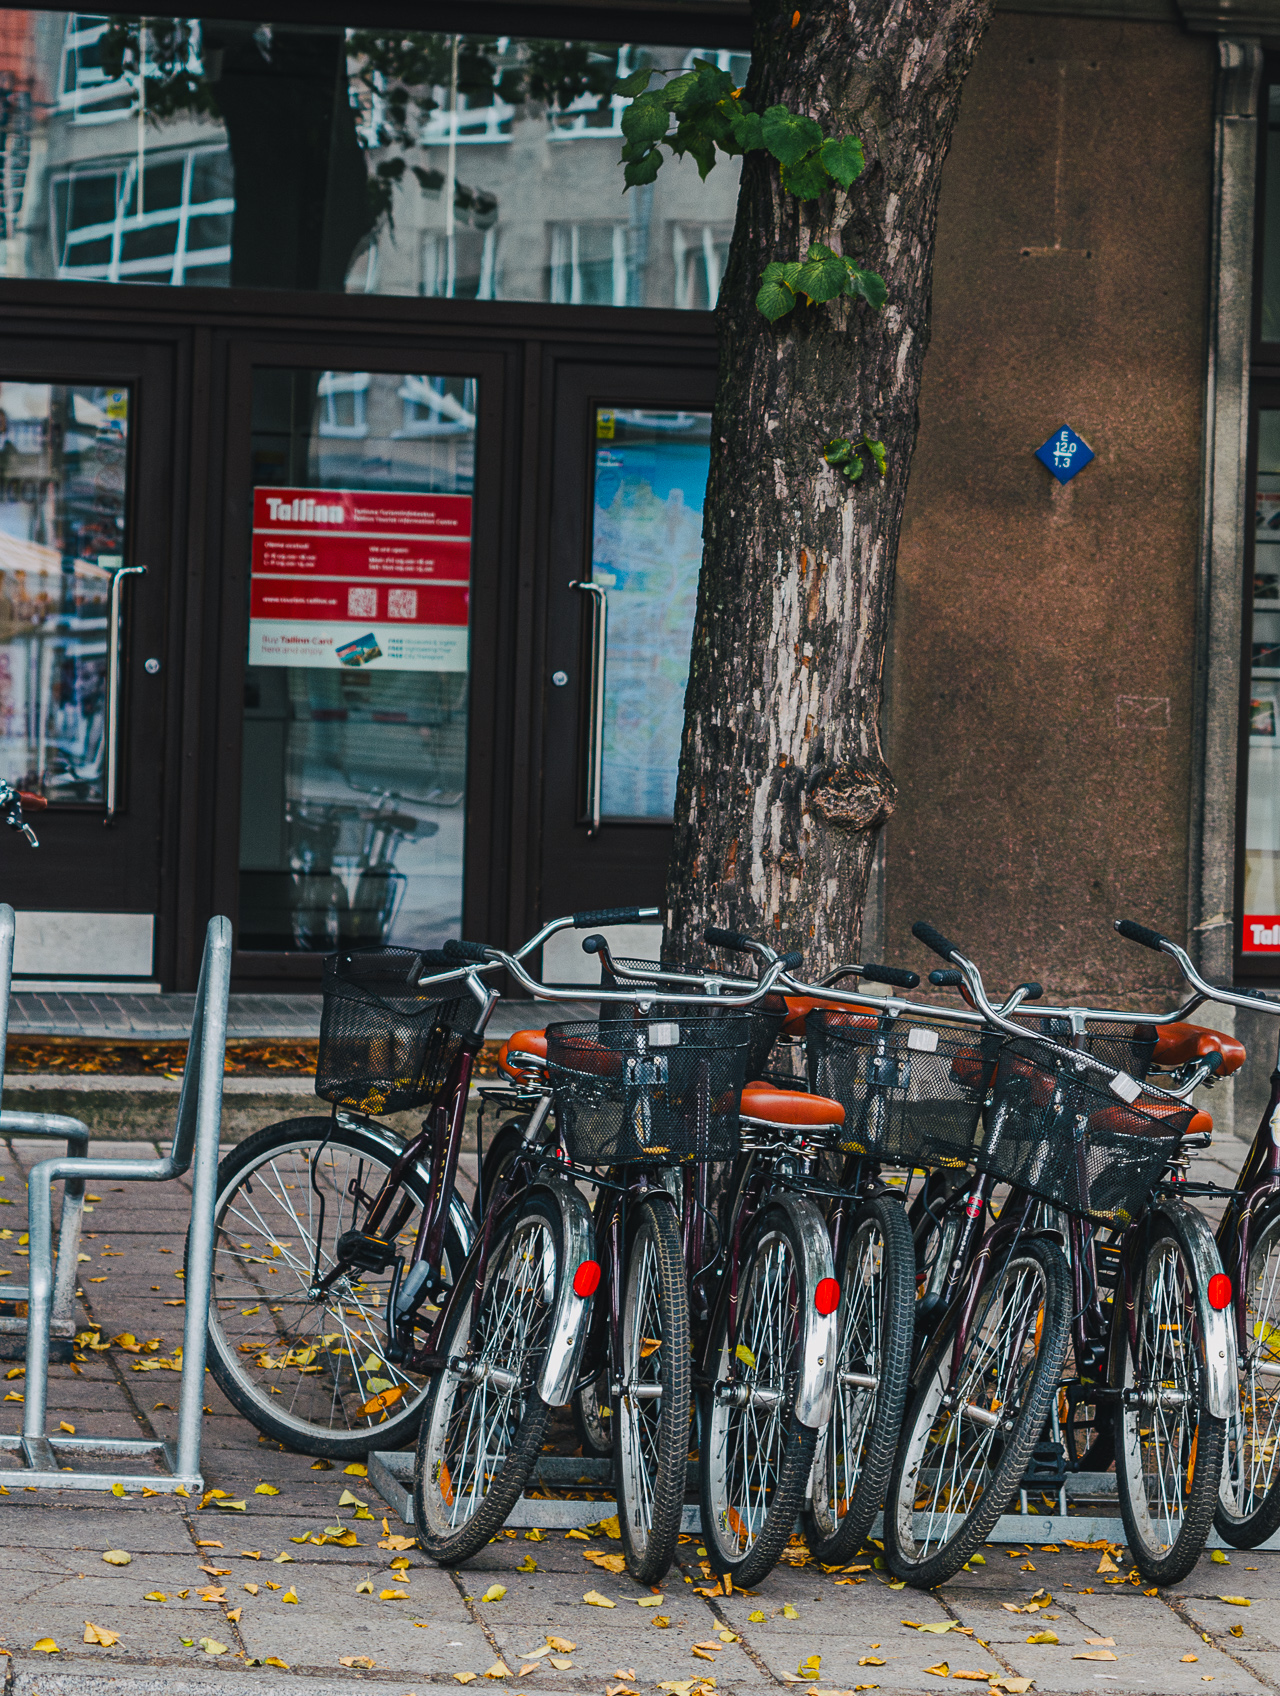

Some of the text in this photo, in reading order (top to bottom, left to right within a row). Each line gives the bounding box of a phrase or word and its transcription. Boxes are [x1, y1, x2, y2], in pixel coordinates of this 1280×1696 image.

[1061, 431, 1069, 441] E
[266, 497, 344, 524] Tallinn
[281, 635, 310, 645] Tallinn
